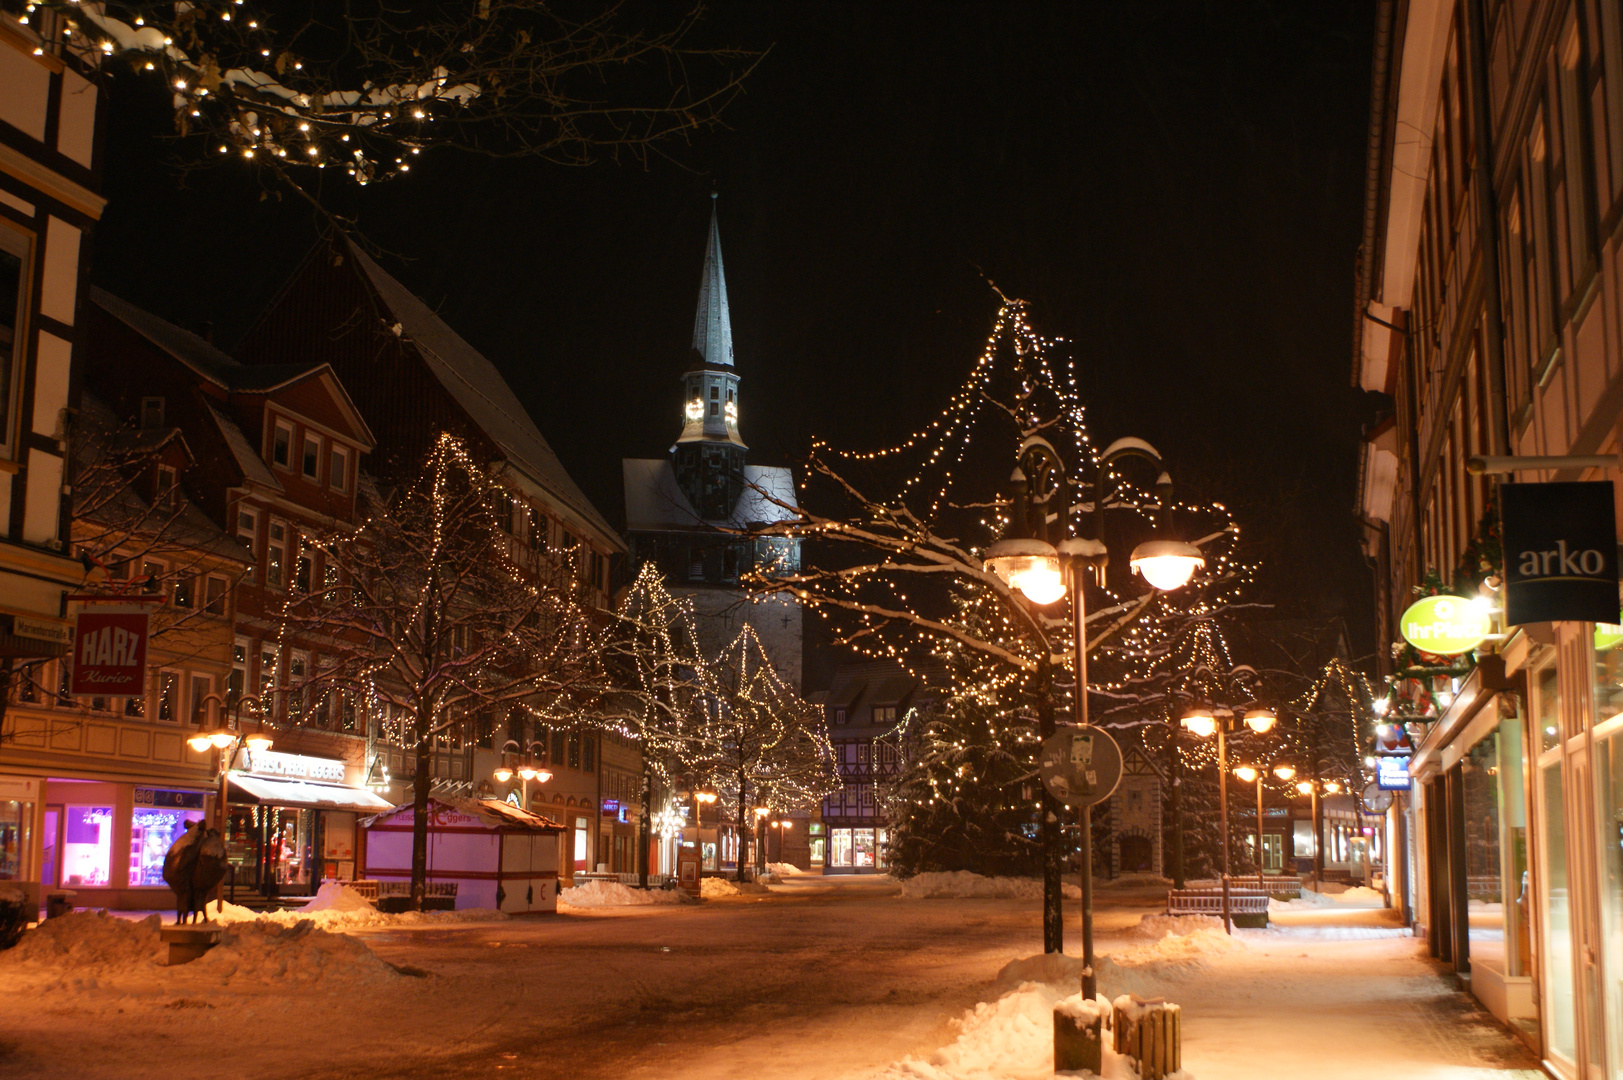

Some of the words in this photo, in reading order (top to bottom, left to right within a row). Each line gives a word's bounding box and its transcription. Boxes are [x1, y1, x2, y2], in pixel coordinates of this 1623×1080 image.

[1518, 539, 1605, 576] arko
[18, 621, 67, 640] Marientorstraße
[1408, 621, 1482, 639] IhrPlatz
[81, 625, 140, 667] HARZ
[80, 671, 136, 684] Kurier
